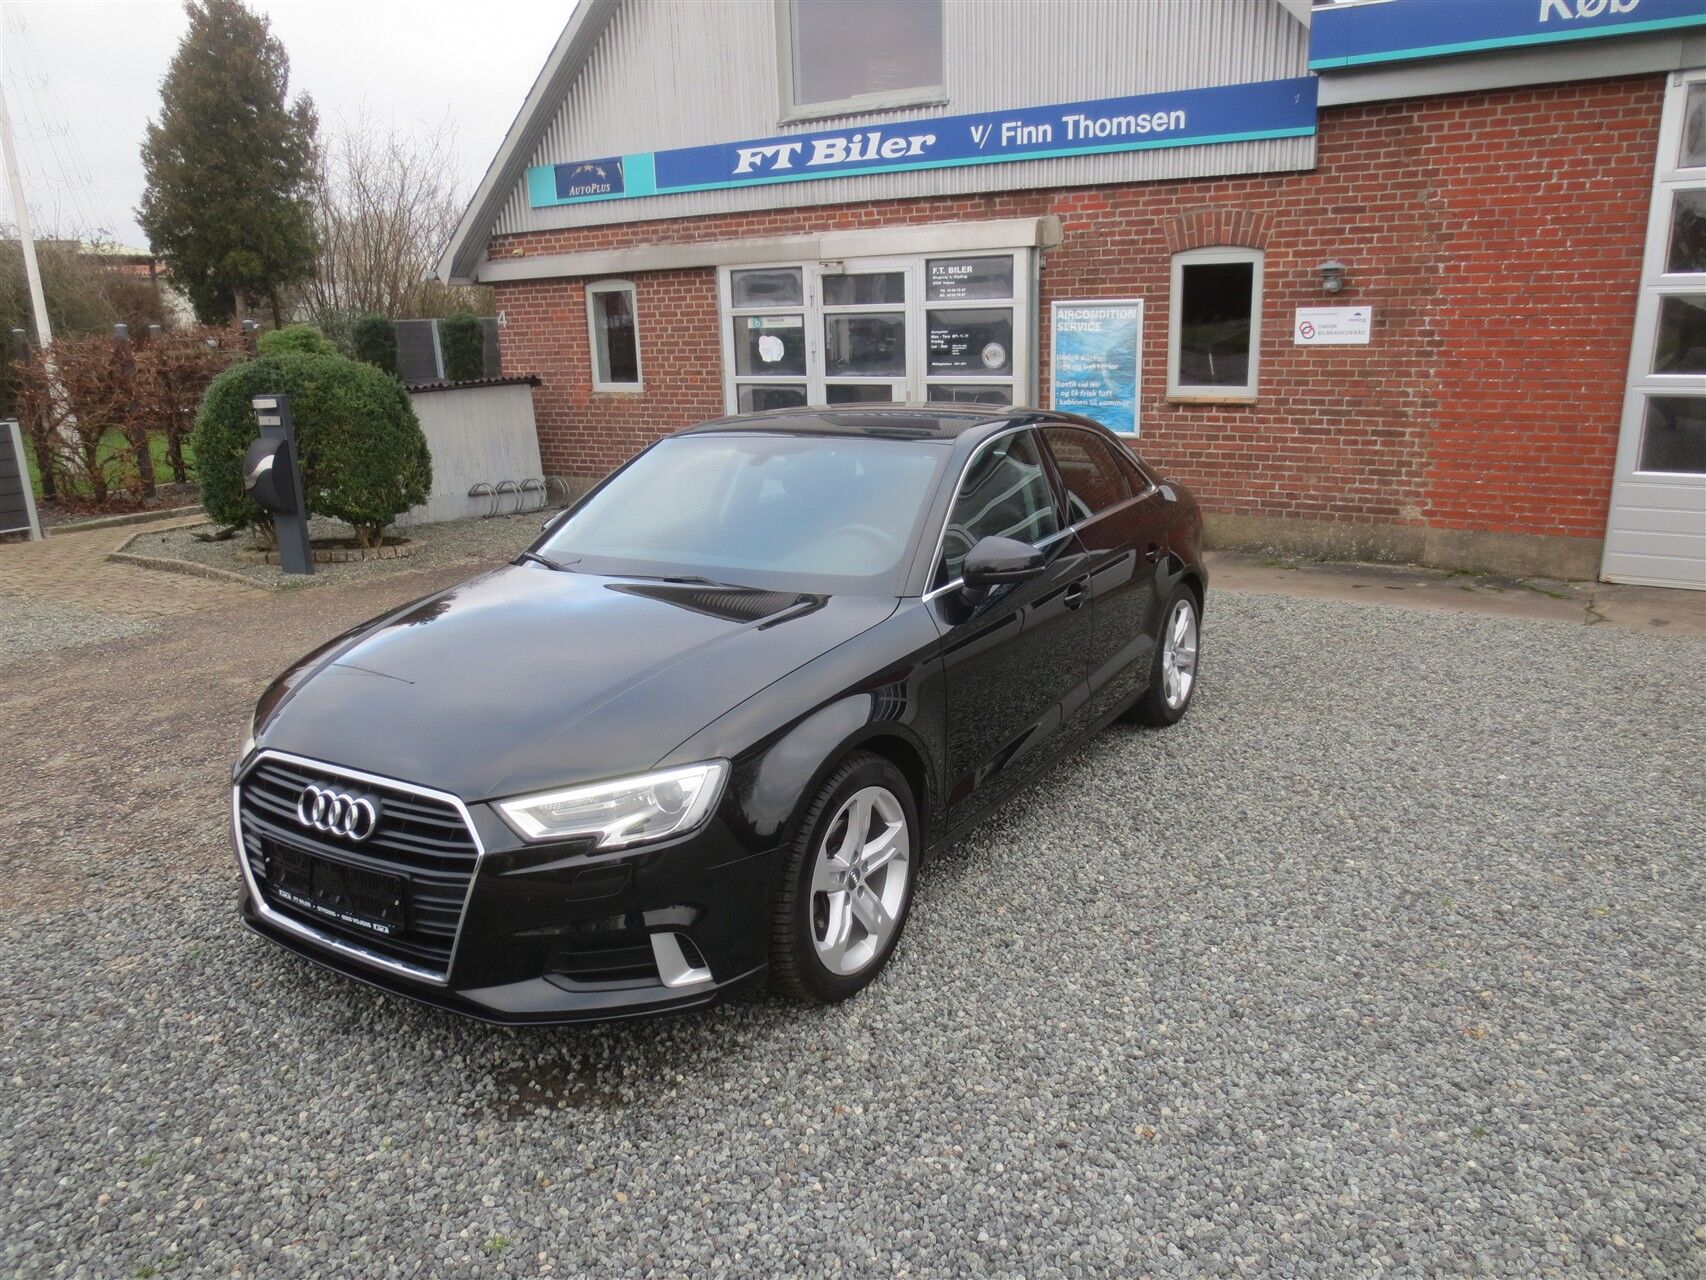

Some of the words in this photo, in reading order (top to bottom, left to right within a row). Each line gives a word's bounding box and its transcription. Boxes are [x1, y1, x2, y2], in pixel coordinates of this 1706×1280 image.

[732, 142, 802, 175] FT
[800, 131, 937, 166] Biler
[1001, 121, 1052, 147] Finn
[1062, 109, 1186, 141] Thomsen
[948, 265, 973, 274] BILER
[498, 309, 508, 328] 4
[1057, 309, 1137, 320] AIRCONDITION
[1057, 321, 1102, 332] SERVICE
[1080, 389, 1097, 397] frisk
